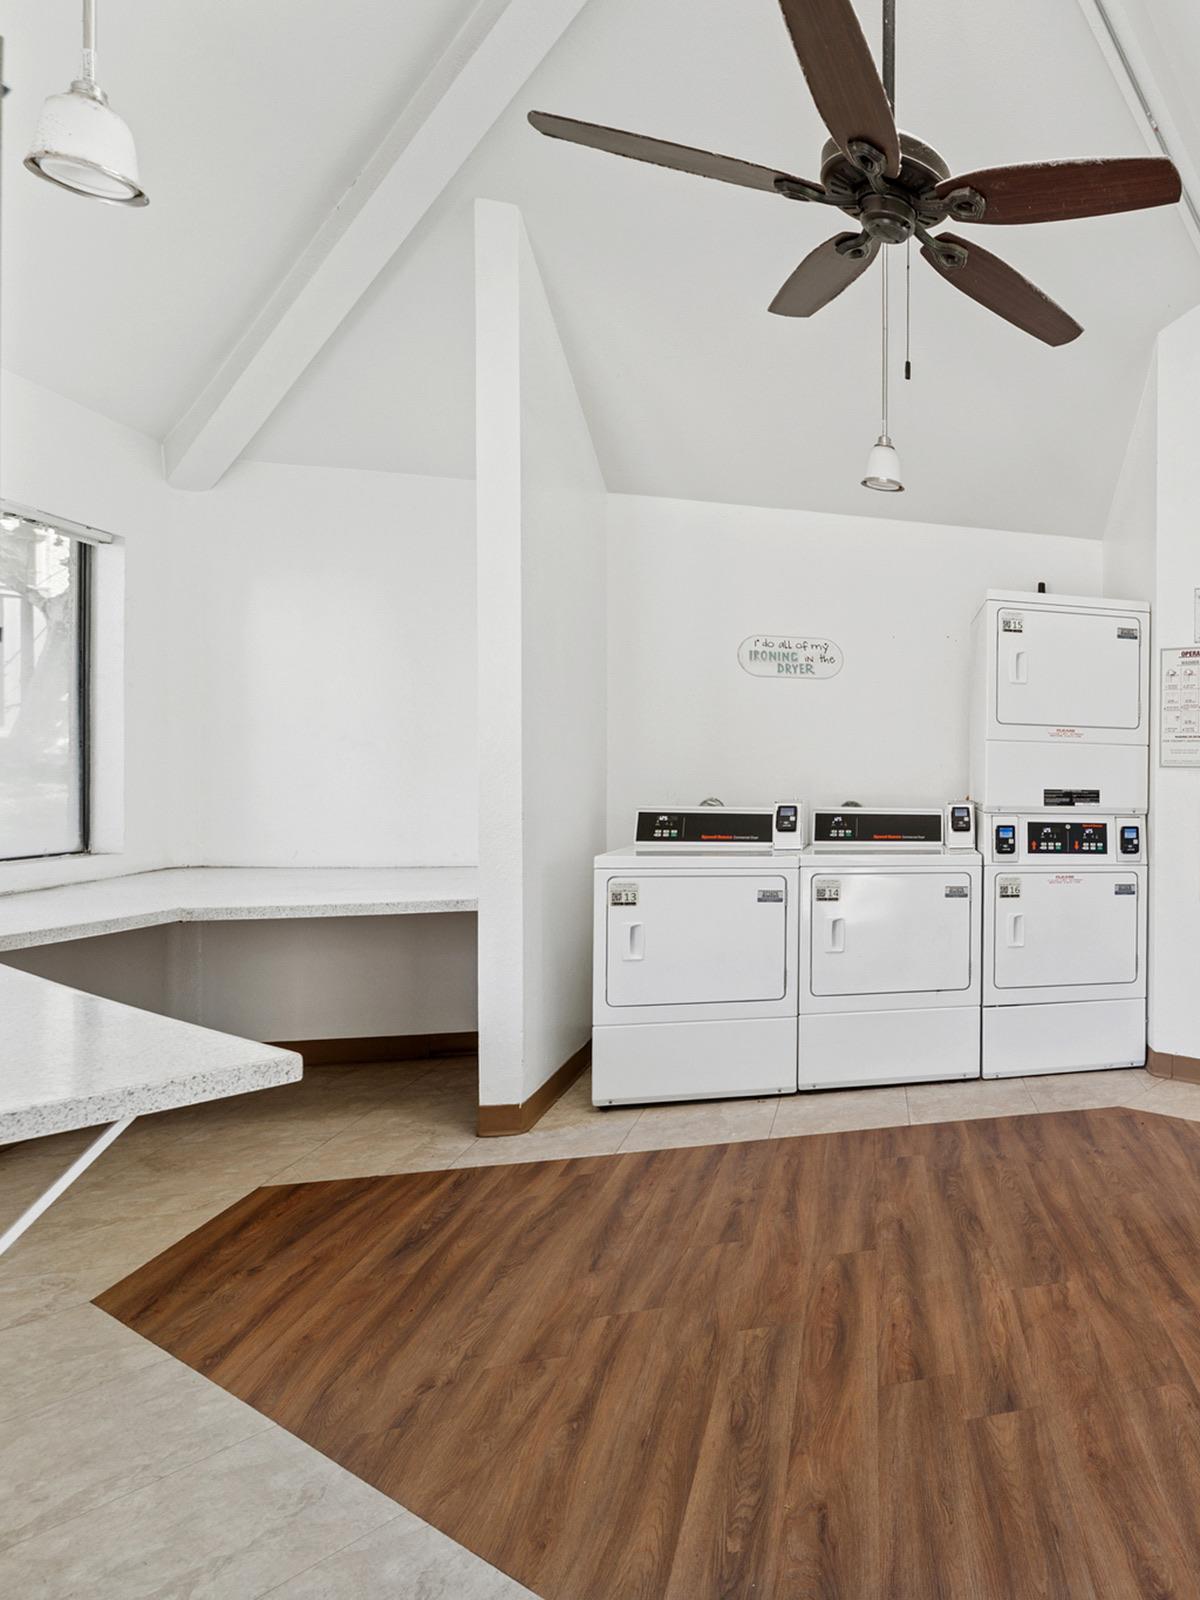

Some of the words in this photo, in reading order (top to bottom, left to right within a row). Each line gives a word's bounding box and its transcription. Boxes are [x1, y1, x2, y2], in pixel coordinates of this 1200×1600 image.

[1012, 620, 1023, 629] 15
[762, 639, 775, 648] do
[778, 640, 792, 649] all
[795, 641, 808, 651] of
[811, 643, 829, 654] my
[749, 650, 798, 662] IRONING
[777, 663, 815, 675] DRYER
[828, 888, 839, 897] 14
[1010, 886, 1020, 894] 16
[624, 892, 637, 901] 13
